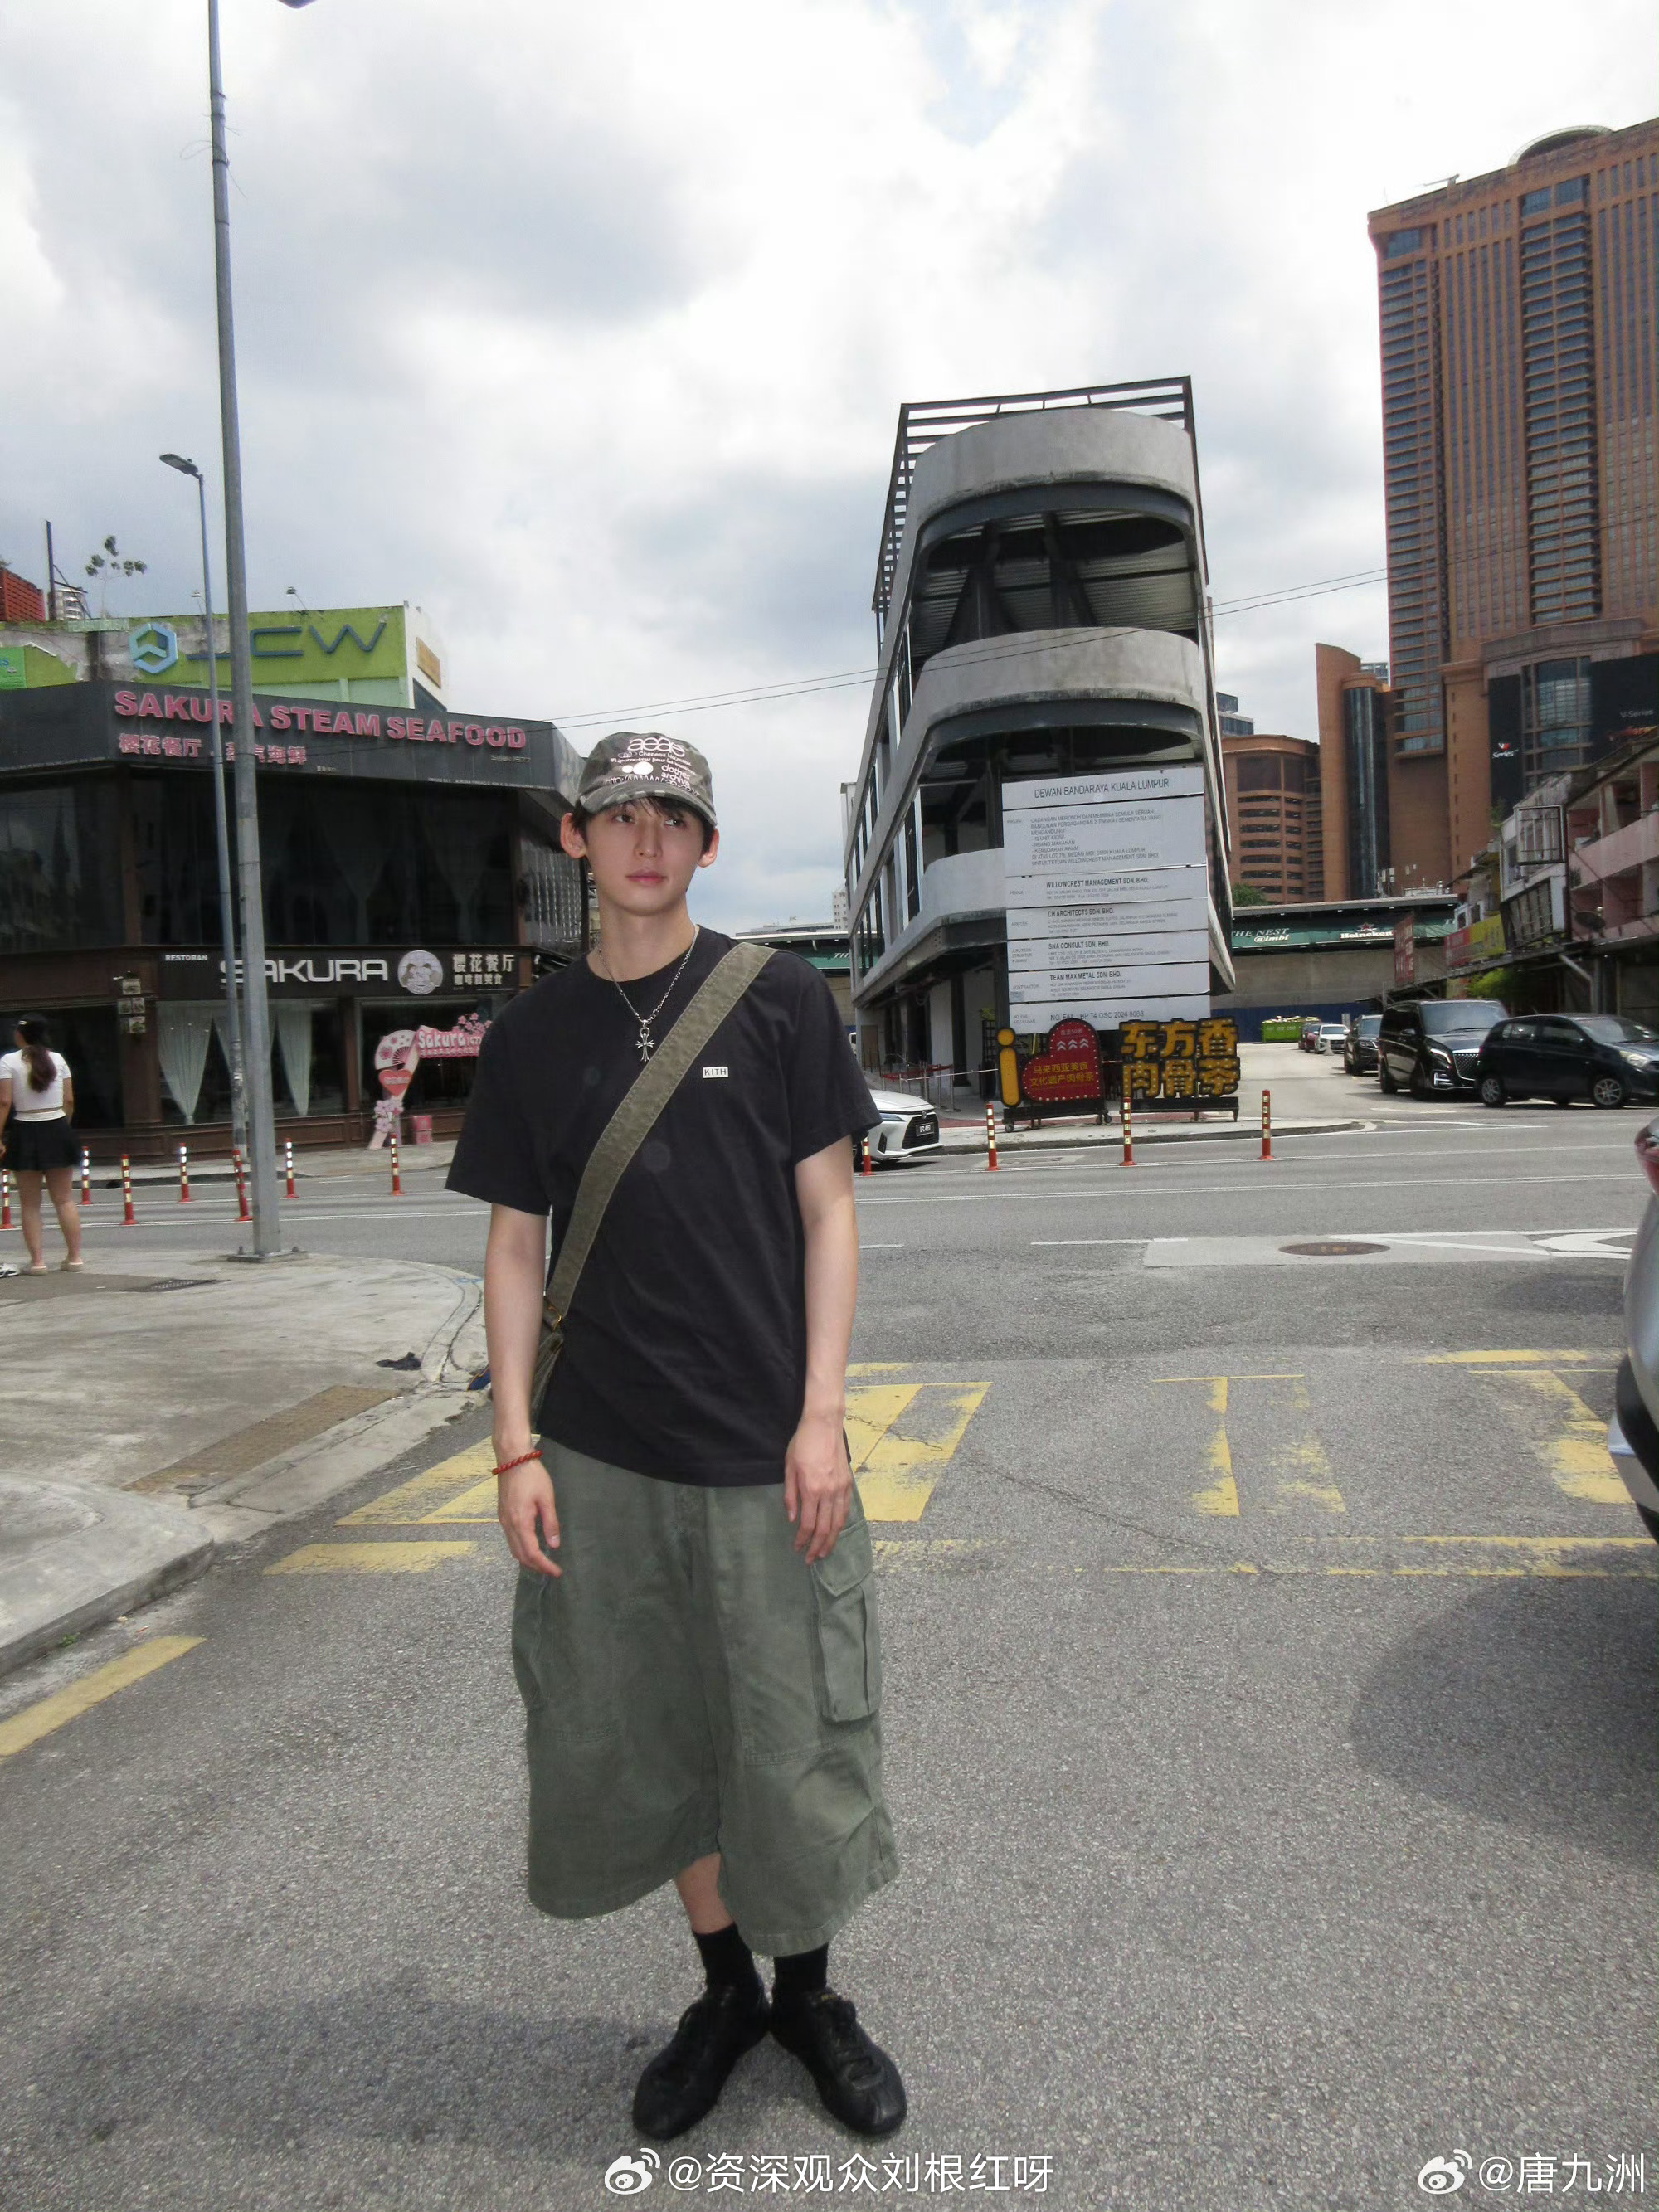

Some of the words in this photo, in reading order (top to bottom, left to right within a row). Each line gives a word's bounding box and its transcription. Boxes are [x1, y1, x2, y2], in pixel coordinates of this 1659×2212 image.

[270, 705, 380, 737] STEAM
[387, 716, 527, 748] SEAFOOD
[119, 732, 202, 758] 樱花餐厅
[1034, 789, 1062, 798] DEWAN
[1063, 785, 1109, 795] BANDARAYA
[1111, 781, 1136, 792] KUALA
[1137, 778, 1169, 790] LUMPUR
[1046, 880, 1085, 888] WILLOWCREST
[1084, 878, 1122, 887] MANAGEMENT
[1056, 908, 1089, 916] ARCHITECTS
[1255, 927, 1290, 936] NEST
[1340, 930, 1394, 939] Heineken
[1060, 941, 1084, 949] CONSULT
[452, 954, 515, 973] 樱花餐厅
[1078, 971, 1096, 980] METAL
[418, 1031, 466, 1048] Sakura
[1121, 1018, 1238, 1058] 东方香
[1121, 1057, 1240, 1097] 肉骨茶
